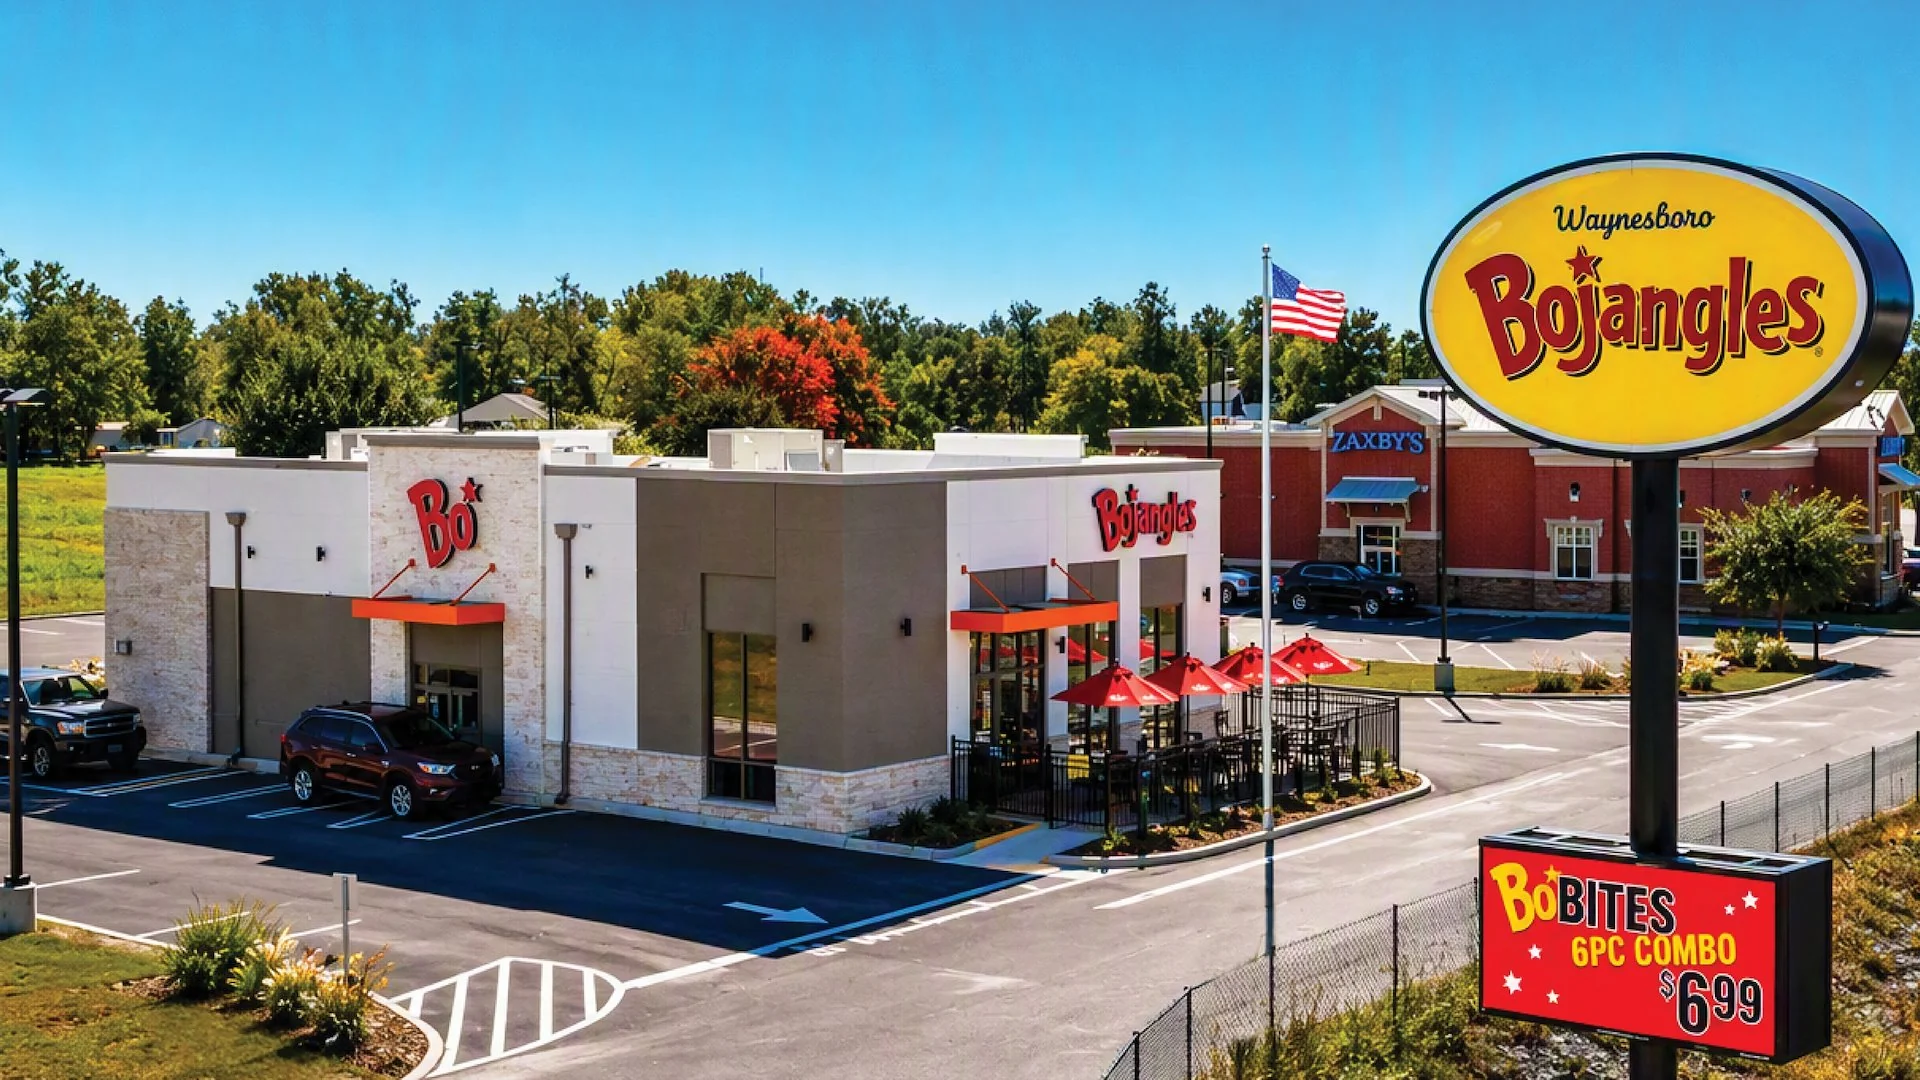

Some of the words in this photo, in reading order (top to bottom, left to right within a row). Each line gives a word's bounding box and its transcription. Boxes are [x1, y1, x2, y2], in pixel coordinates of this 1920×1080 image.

[1553, 202, 1715, 240] Waynesboro
[1465, 246, 1824, 381] Bojangles
[1331, 431, 1424, 454] ZAXBY'S
[407, 479, 479, 568] Bo
[1091, 484, 1197, 552] Bojangles
[1571, 935, 1626, 967] 6PC
[1634, 932, 1737, 967] COMBO
